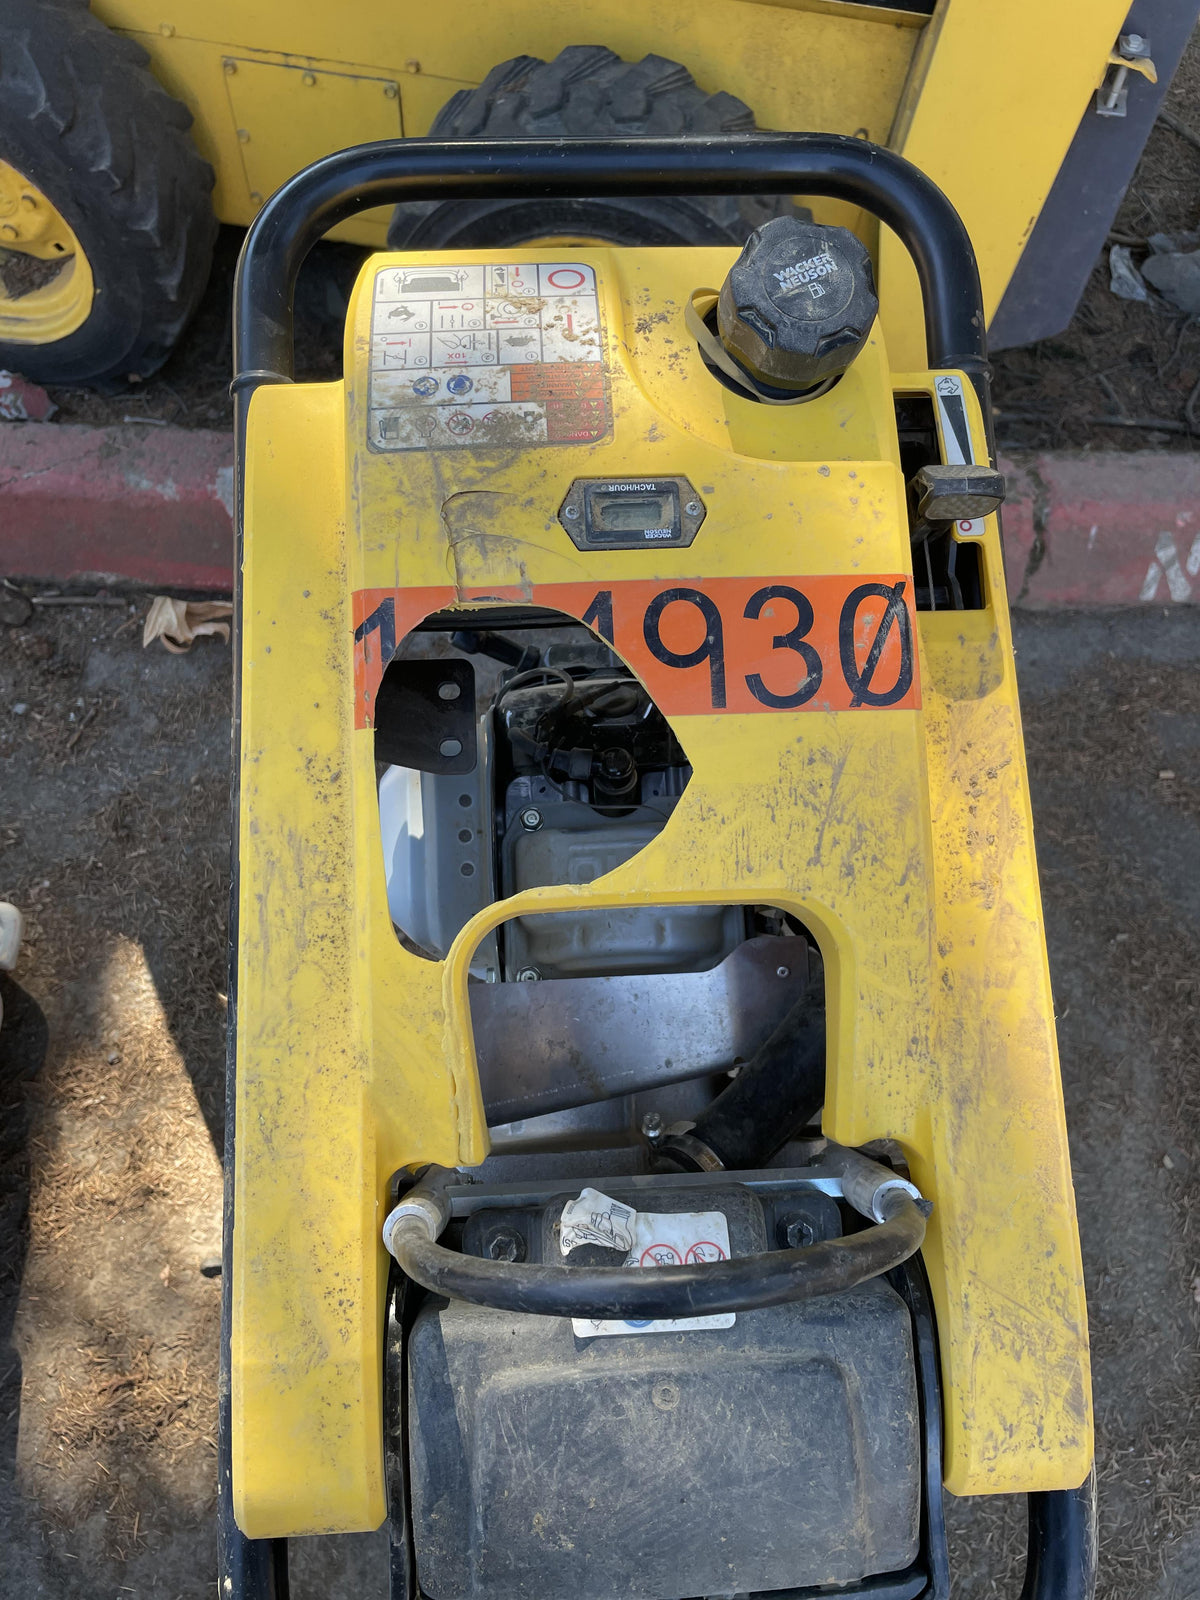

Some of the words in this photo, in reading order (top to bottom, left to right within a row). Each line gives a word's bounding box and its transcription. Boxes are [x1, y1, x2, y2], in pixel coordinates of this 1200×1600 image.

[773, 252, 832, 281] WACKER
[779, 260, 838, 292] NEUSON
[608, 483, 657, 492] TACH/HOUR
